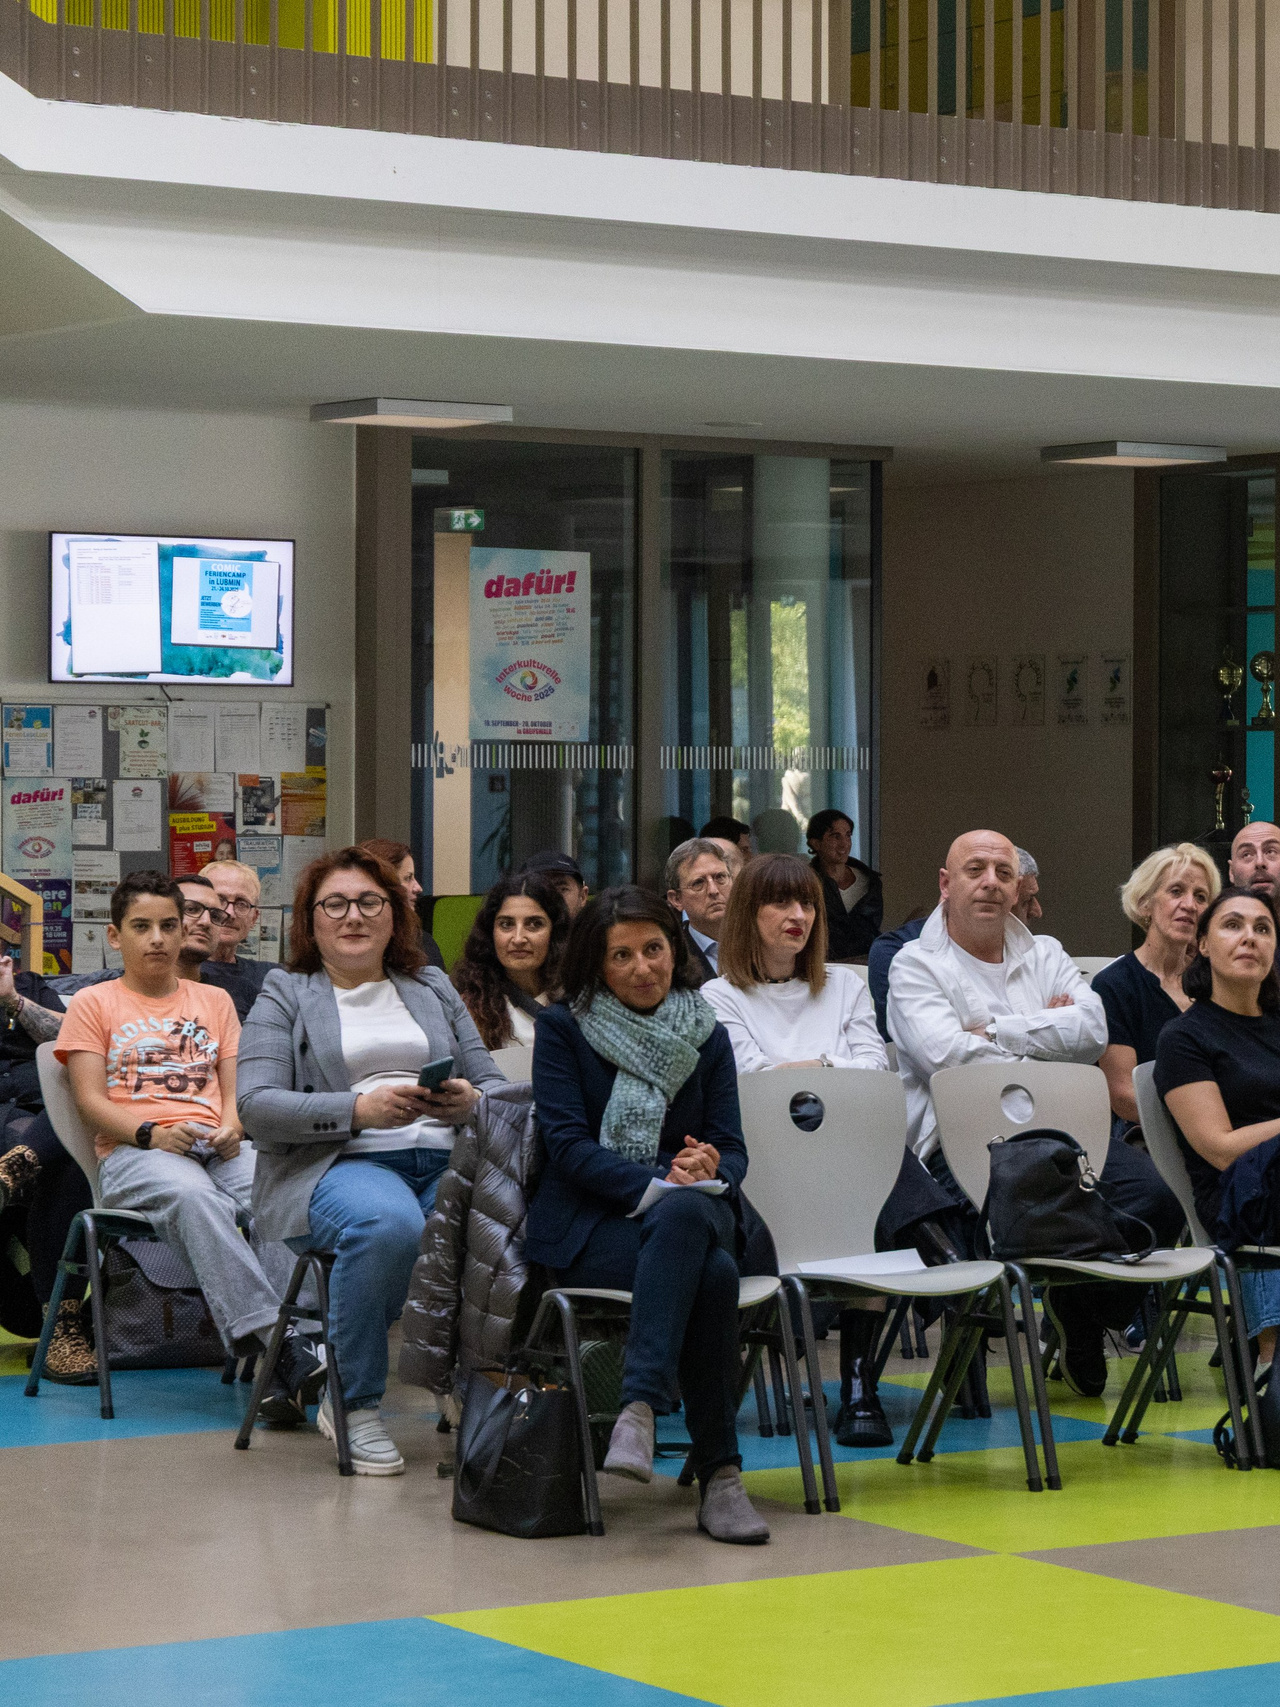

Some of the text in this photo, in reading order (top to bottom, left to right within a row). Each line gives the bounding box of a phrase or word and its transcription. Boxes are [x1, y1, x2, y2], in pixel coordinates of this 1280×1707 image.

[204, 570, 247, 578] FERIENCAMP
[211, 563, 241, 571] COMIC
[484, 568, 577, 598] dafür!
[495, 658, 562, 685] Interkulturelle
[534, 685, 555, 701] 2025
[11, 788, 65, 805] dafür!
